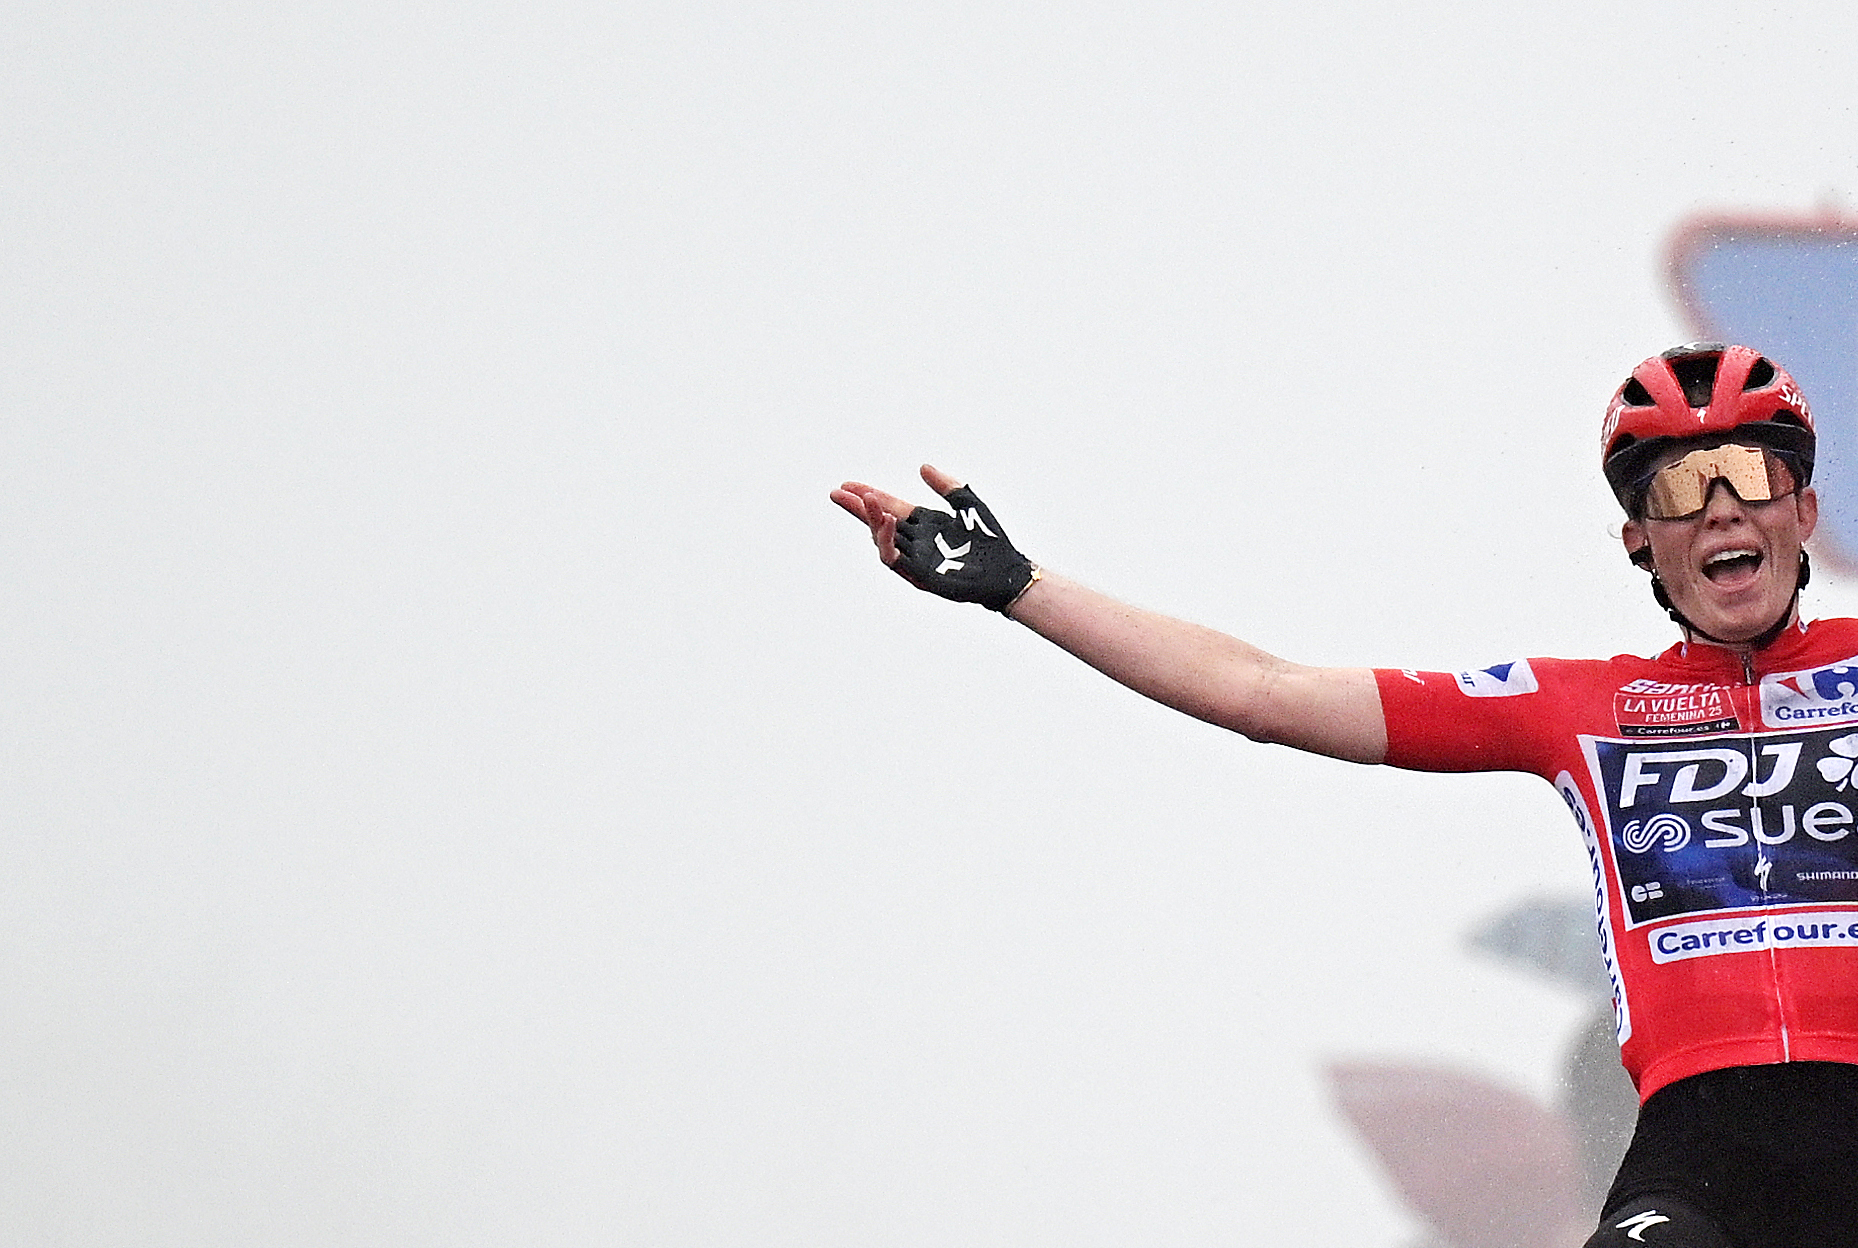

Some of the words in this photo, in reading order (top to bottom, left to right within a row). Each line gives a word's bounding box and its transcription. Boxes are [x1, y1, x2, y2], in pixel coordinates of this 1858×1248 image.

[1624, 698, 1646, 712] LA
[1651, 691, 1721, 713] VUELTA
[1645, 709, 1706, 723] FEMENINA
[1708, 705, 1723, 717] 25
[1619, 742, 1803, 809] FDJ
